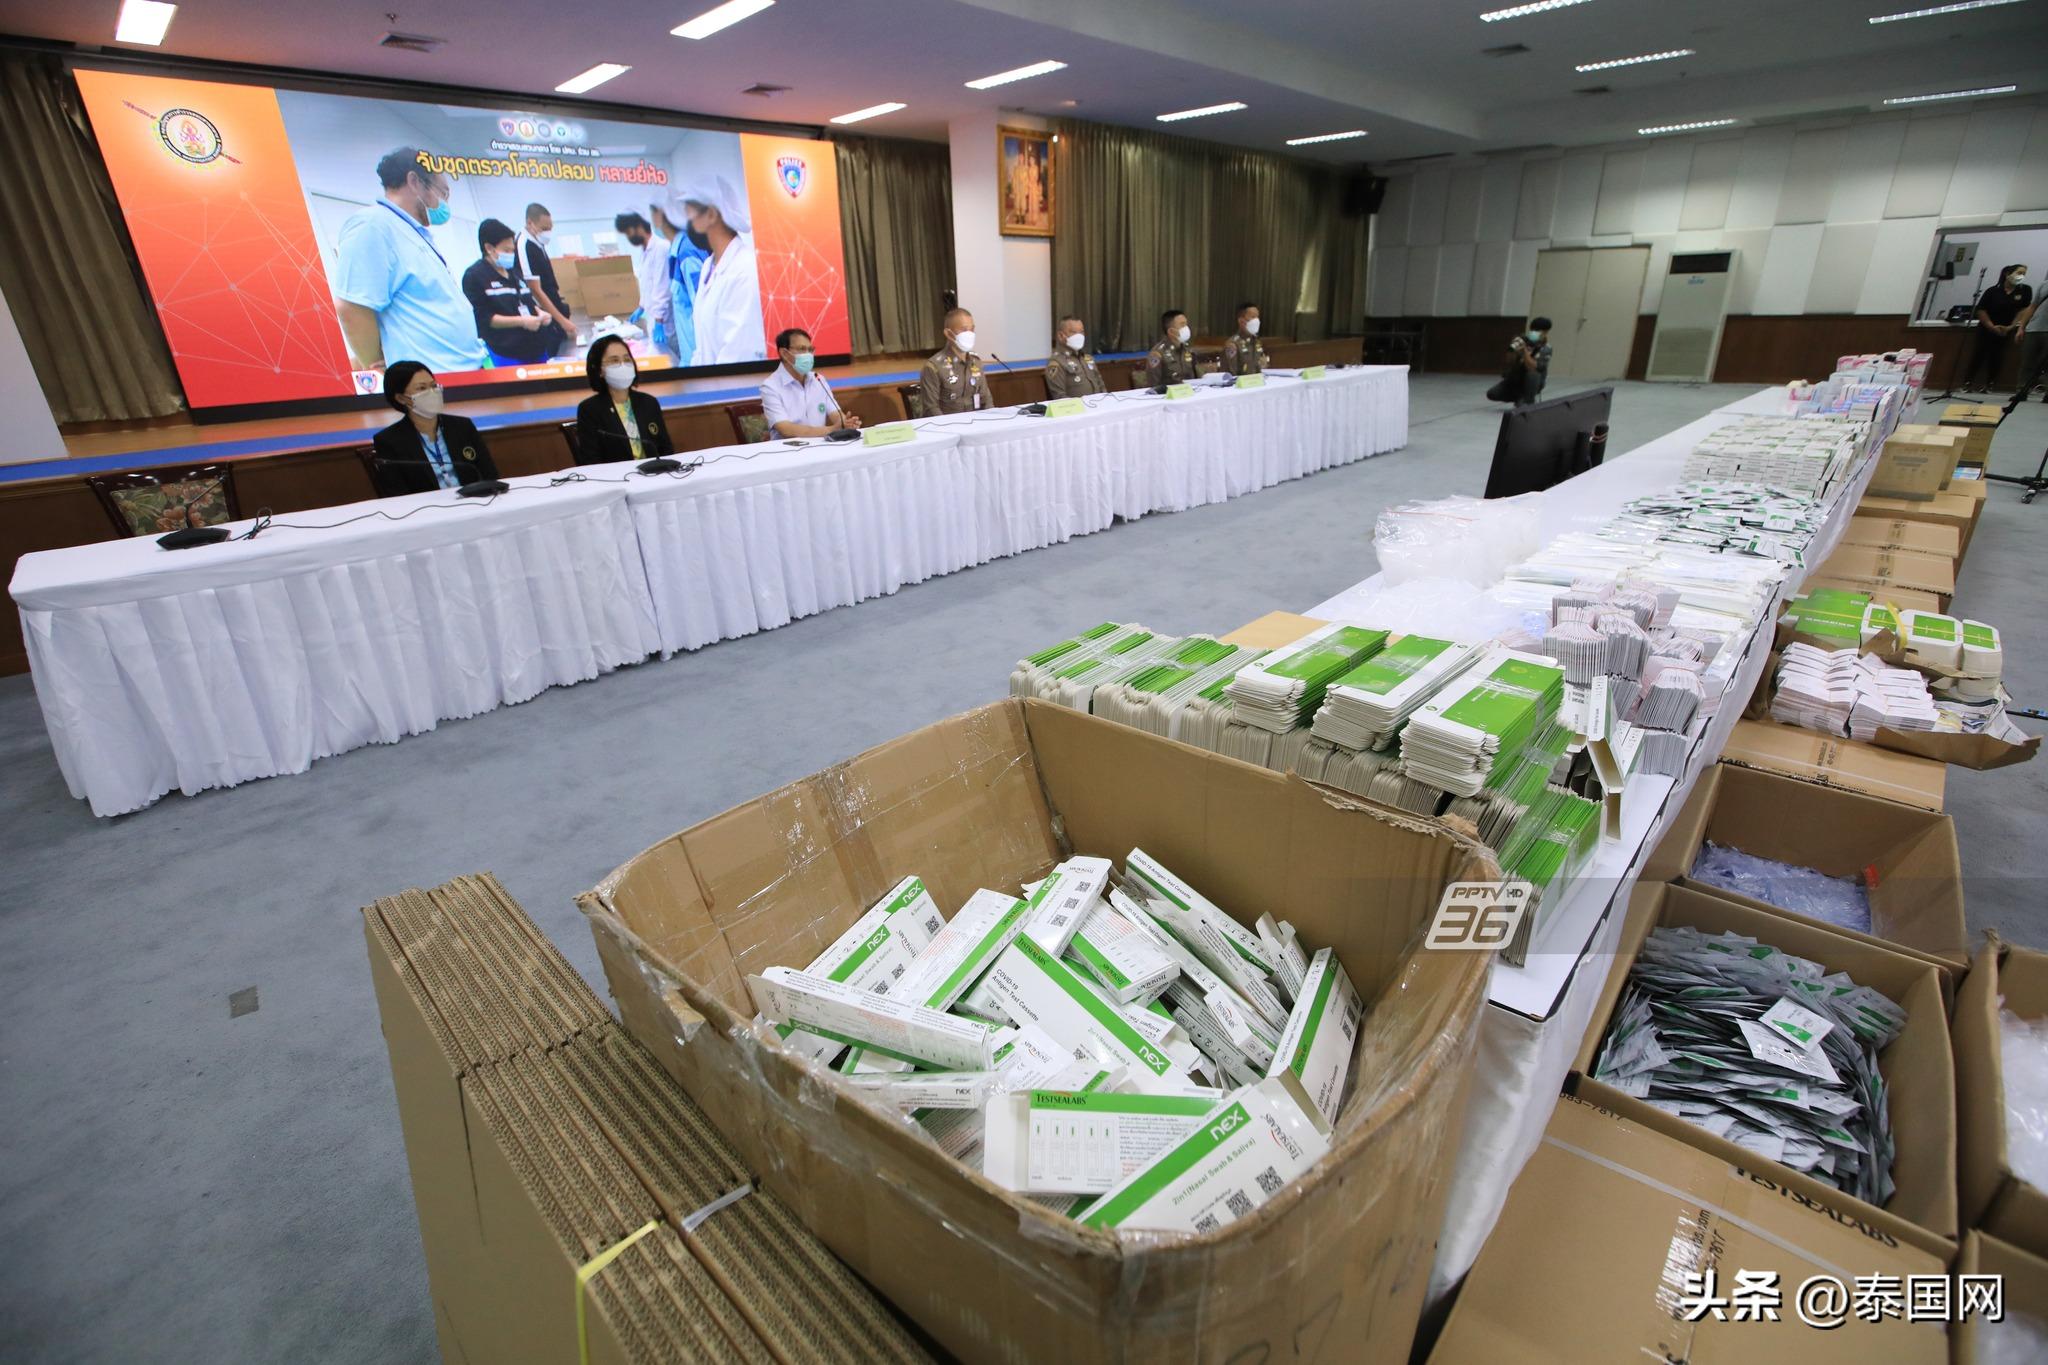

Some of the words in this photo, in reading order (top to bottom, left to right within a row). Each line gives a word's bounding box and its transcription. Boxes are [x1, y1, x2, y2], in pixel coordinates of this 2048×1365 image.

[416, 152, 594, 182] จับชุดตรวจโควิดปลอม
[598, 160, 668, 186] หลายยี่ห้อ
[996, 968, 1018, 991] COVID-19
[991, 975, 1011, 994] Antigen
[1010, 988, 1022, 1004] Test
[1018, 1000, 1040, 1022] Cassette
[1036, 1094, 1087, 1104] TESTSEALABS
[1208, 1159, 1228, 1178] Swab
